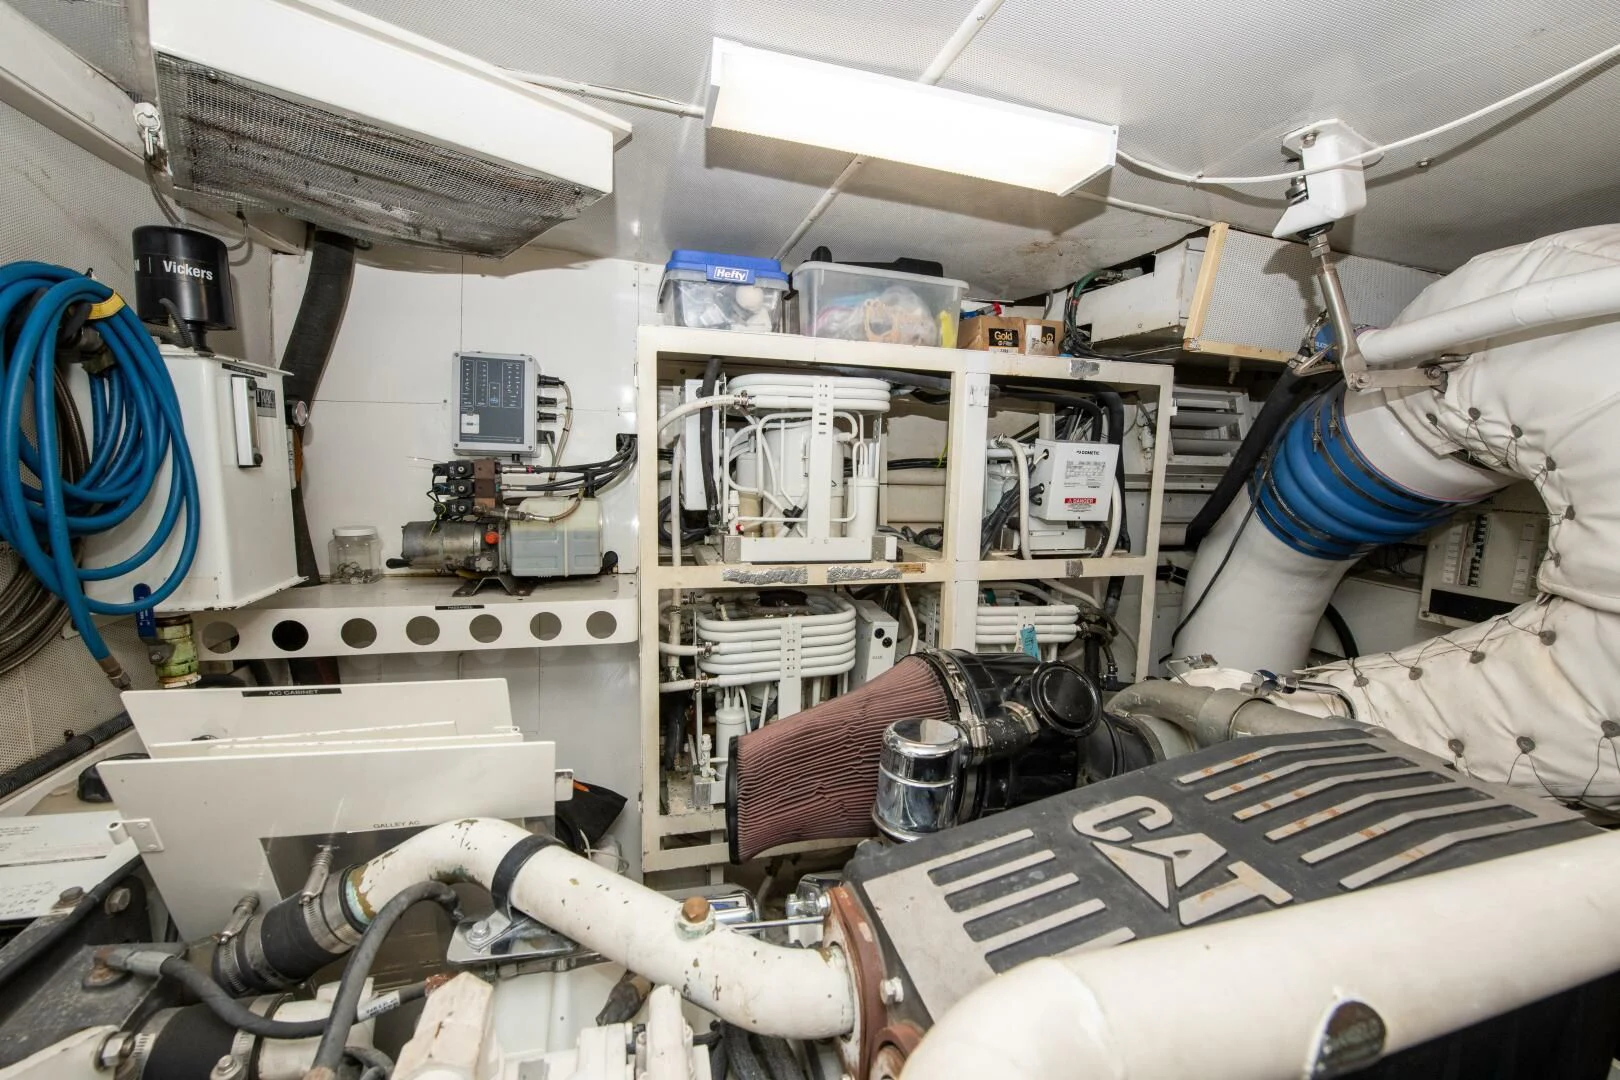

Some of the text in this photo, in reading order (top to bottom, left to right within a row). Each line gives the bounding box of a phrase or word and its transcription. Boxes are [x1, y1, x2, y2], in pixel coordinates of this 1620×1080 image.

[163, 260, 213, 280] Vickers
[716, 268, 746, 280] Hefty
[994, 330, 1013, 341] Gold
[1072, 795, 1294, 926] CAT
